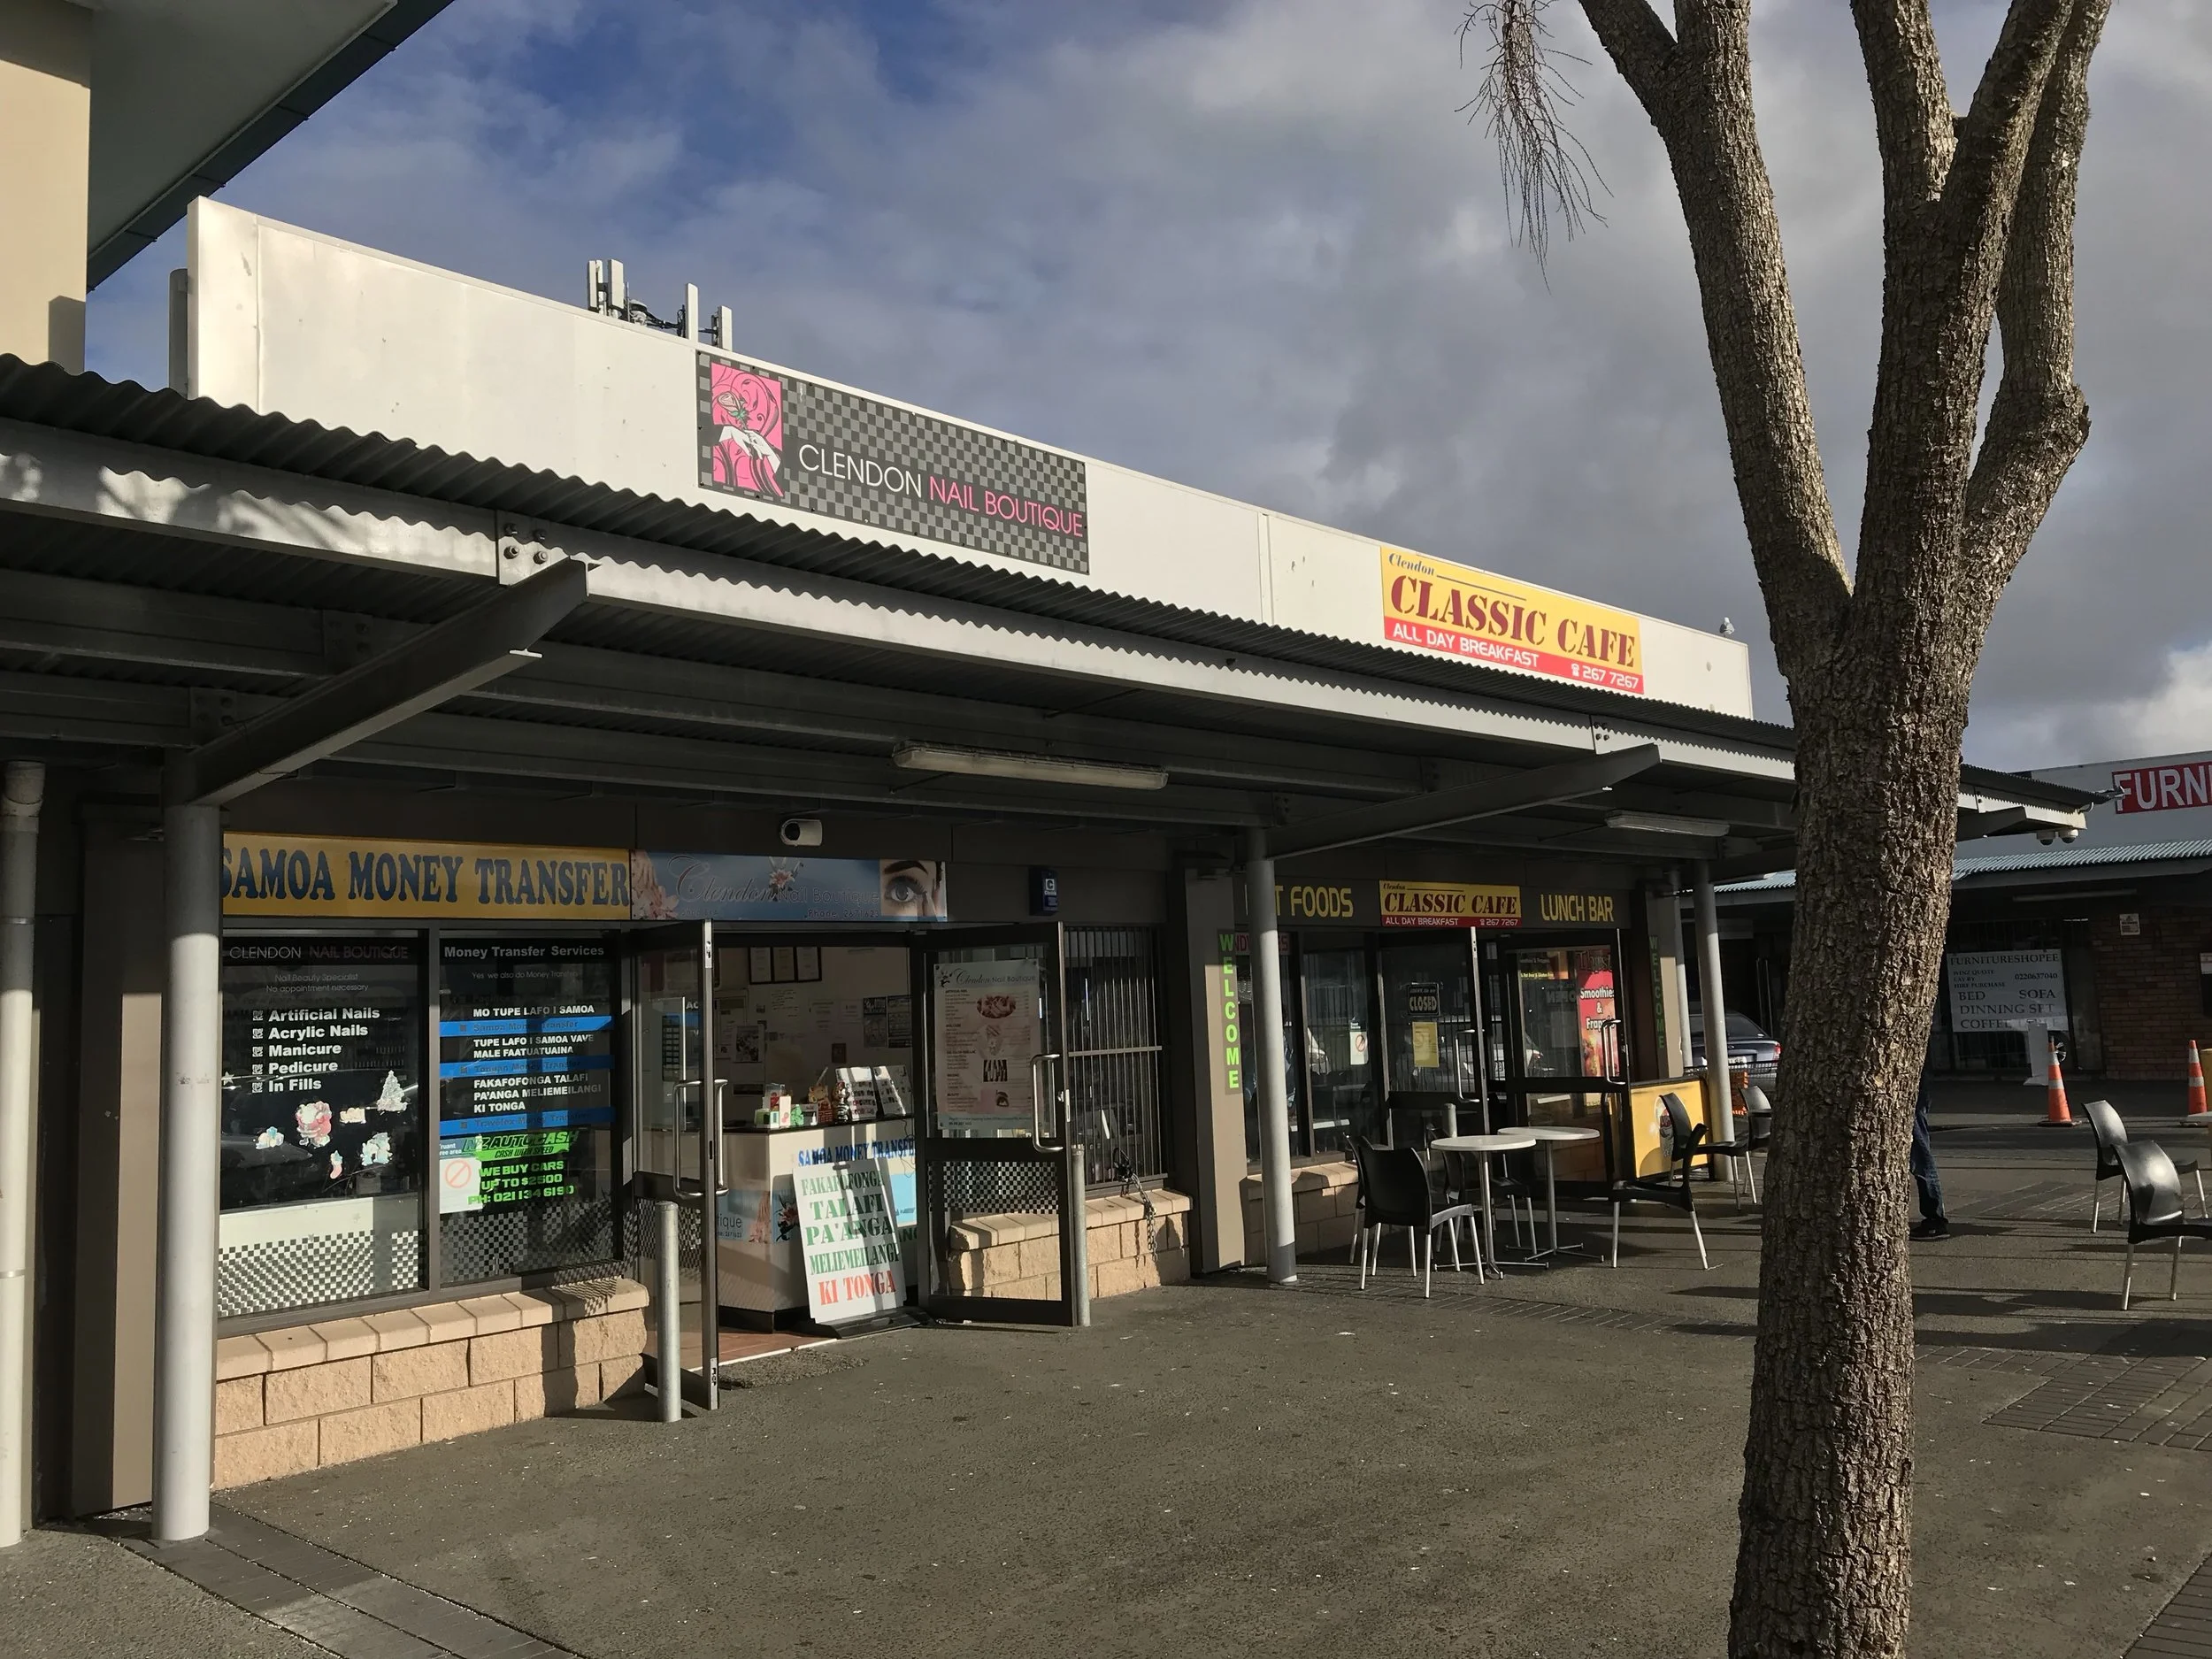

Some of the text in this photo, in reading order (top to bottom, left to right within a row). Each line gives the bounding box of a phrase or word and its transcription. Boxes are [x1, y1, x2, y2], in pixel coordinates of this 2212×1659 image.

[799, 444, 1084, 538] CLENDON NAIL BOUTIQUE
[1388, 553, 1435, 576] Clendon
[1391, 575, 1635, 668] CLASSIC CAFE
[1393, 623, 1539, 668] ALL DAY BREAKFAST
[1582, 665, 1639, 689] 267 7267
[222, 847, 630, 907] SAMOA MONEY TRANSFER
[667, 855, 879, 907] Clendon Nail Boutique
[1290, 886, 1354, 918] FOODS
[1385, 893, 1517, 915] CLASSIC CAFE
[1540, 893, 1615, 922] LUNCH BAR
[1417, 918, 1459, 926] BREAKFAST
[229, 945, 409, 960] CLENDON NAIL BOUTIQUE
[444, 945, 604, 959] Money Transfer Services
[1949, 953, 2060, 965] FURNITURESHOPEE
[280, 984, 330, 994] appointment
[331, 983, 369, 993] necessary
[1648, 935, 1665, 1048] WELCOME
[1957, 988, 2056, 1001] BED SOFA
[472, 1008, 490, 1018] MO
[493, 1007, 521, 1017] TUPE
[524, 1006, 550, 1016] LAFO
[559, 1004, 595, 1015] SAMOA
[1219, 934, 1240, 1088] WELCOME
[1409, 995, 1437, 1011] CLOSED
[1596, 1002, 1602, 1013] &
[1959, 1003, 2055, 1015] DINNING SET
[268, 1007, 380, 1022] Artificial Nails
[268, 1024, 368, 1041] Acrylic Nails
[473, 1039, 500, 1048] TUPE
[502, 1037, 527, 1046] LAFO
[535, 1035, 569, 1045] SAMOA
[570, 1034, 594, 1043] VAVE
[268, 1043, 342, 1057] Manicure
[473, 1046, 573, 1059] MALE FAATUATUAINA
[268, 1061, 338, 1074] Pedicure
[268, 1078, 322, 1093] In Fills
[473, 1072, 588, 1088] FAKAFOFONGA TALAFI
[473, 1084, 602, 1102] PA'ANGA MELIEMEILANGI
[473, 1101, 526, 1113] KI TONGA
[495, 1148, 514, 1158] CASH
[533, 1146, 554, 1156] SPEED
[798, 1146, 833, 1167] SAMOA
[835, 1142, 868, 1163] MONEY
[479, 1161, 565, 1178] WE BUY CARS
[480, 1173, 563, 1191] UP TO $2500
[800, 1170, 886, 1196] FAKAFOFONGA
[467, 1194, 491, 1205] PH:
[542, 1185, 575, 1198] 6190
[809, 1193, 884, 1221] TALAFI
[804, 1216, 893, 1247] PA'ANGA
[809, 1242, 899, 1275] MELIEMEILANGI
[818, 1270, 896, 1306] KI TONGA
